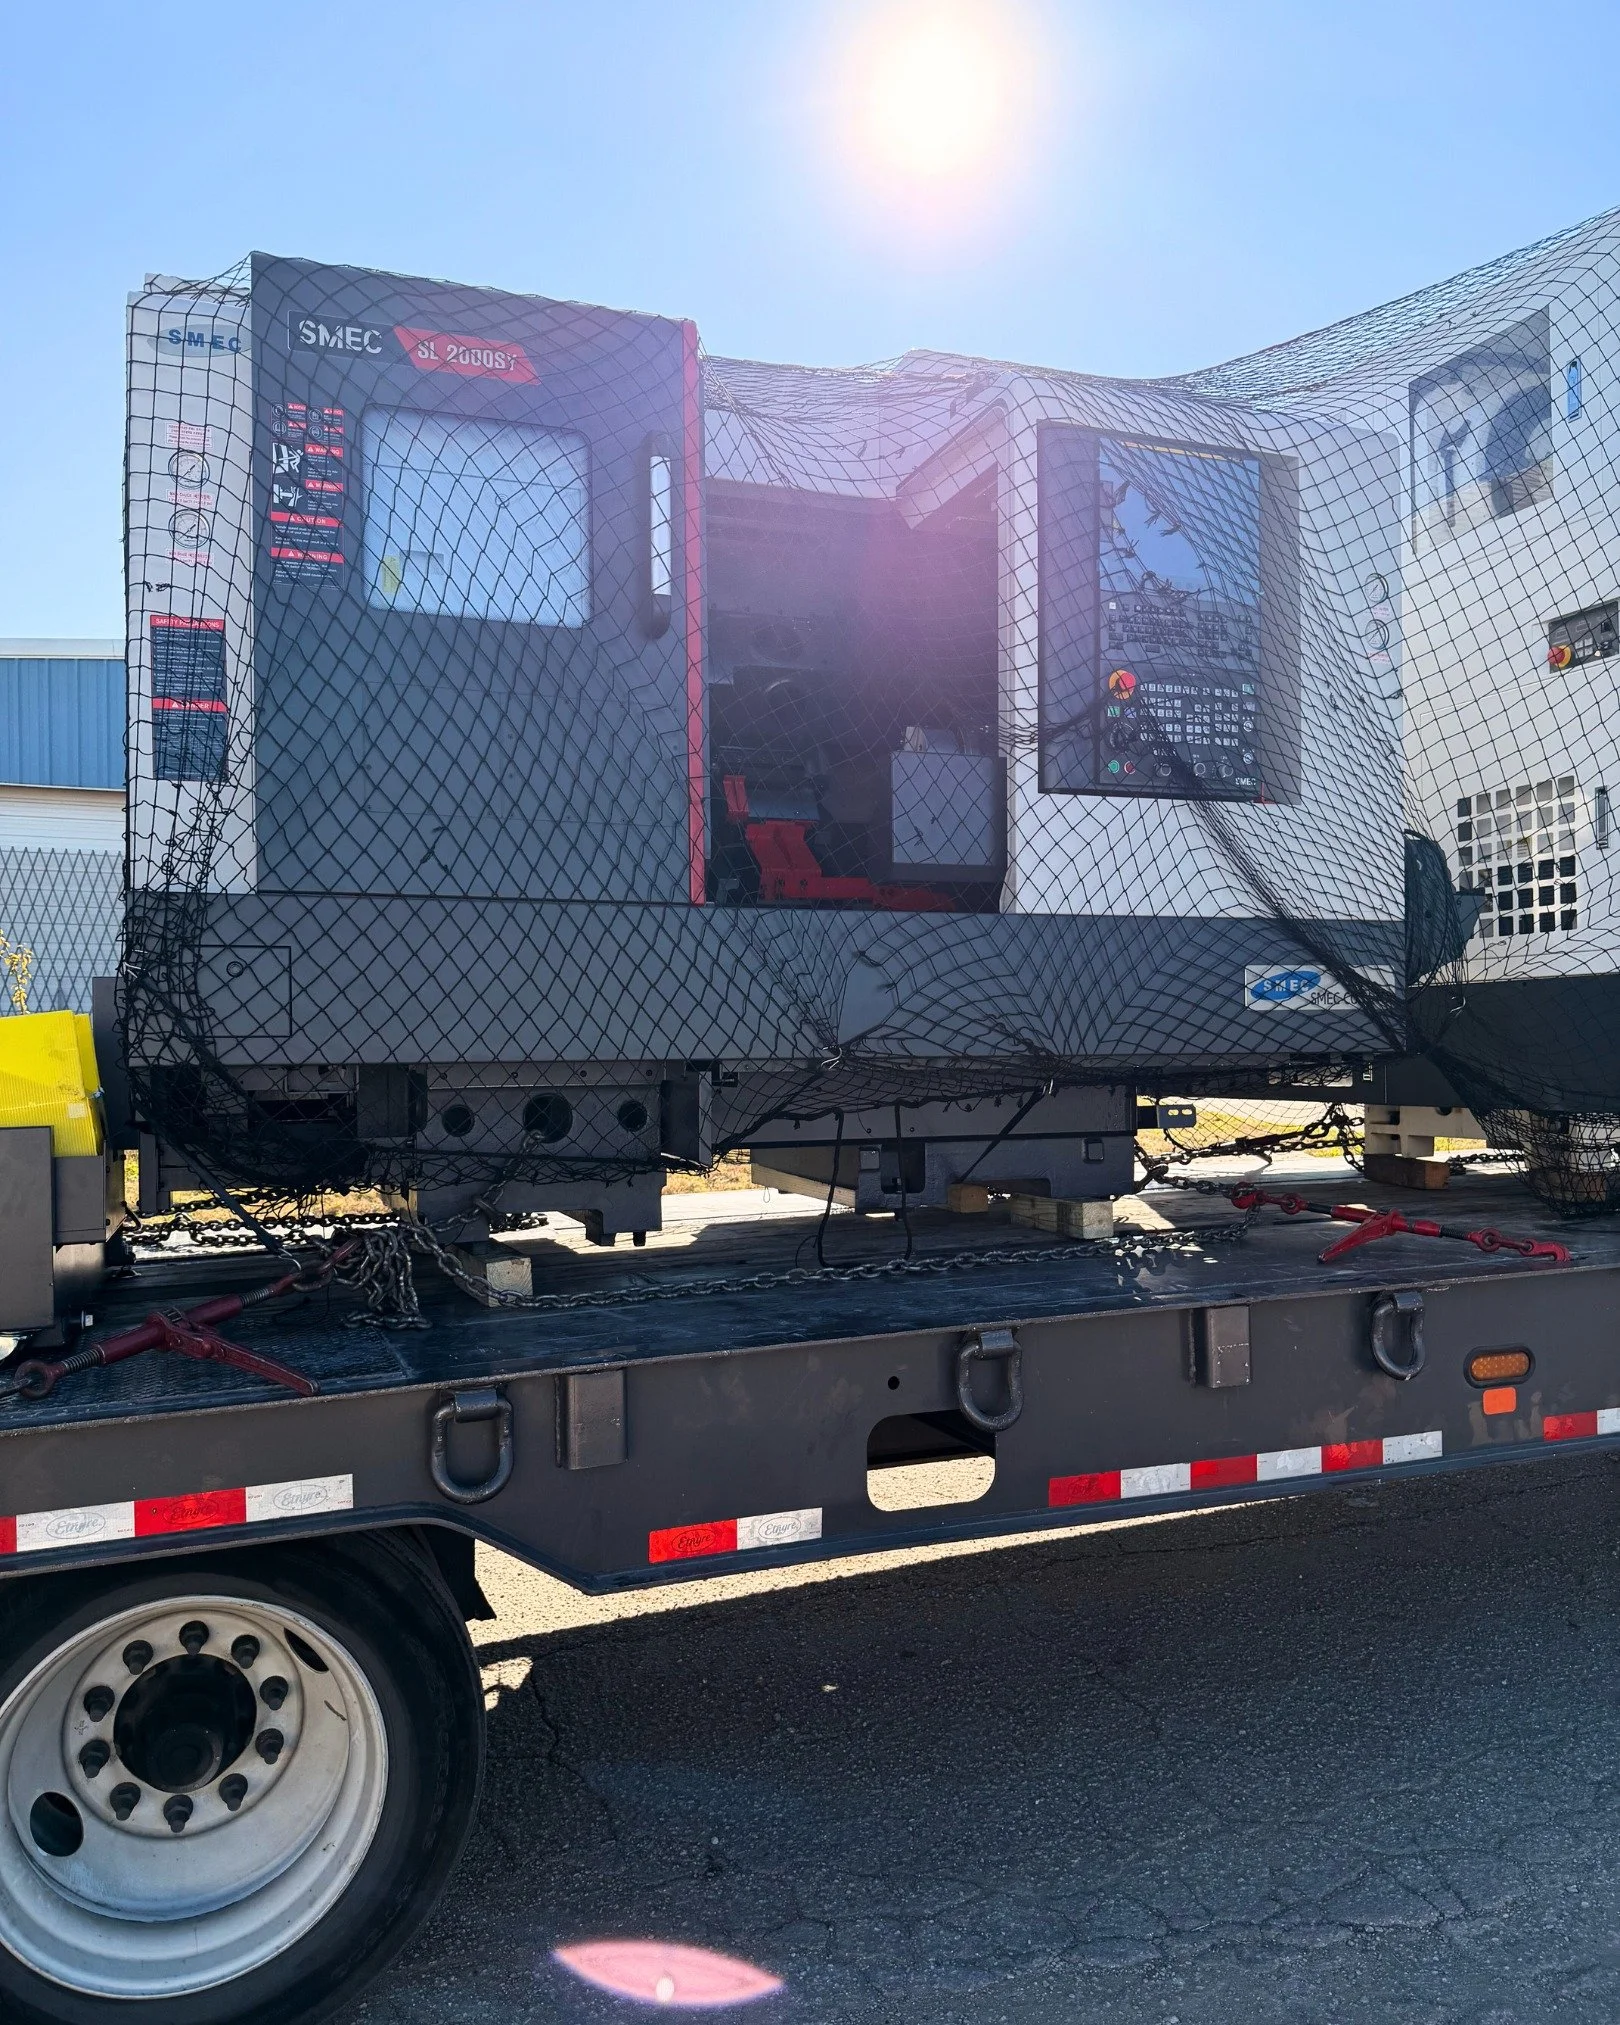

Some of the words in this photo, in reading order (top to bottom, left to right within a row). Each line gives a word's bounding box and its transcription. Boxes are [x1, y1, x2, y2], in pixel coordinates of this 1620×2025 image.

[168, 329, 242, 352] SMEC
[298, 320, 383, 354] SMEC
[417, 340, 439, 361] SL
[446, 344, 517, 371] 2000SY
[296, 516, 326, 525] CAUTON
[1263, 979, 1310, 992] SMEC
[1310, 991, 1340, 1005] SMEC
[764, 1520, 797, 1536] Etnyre
